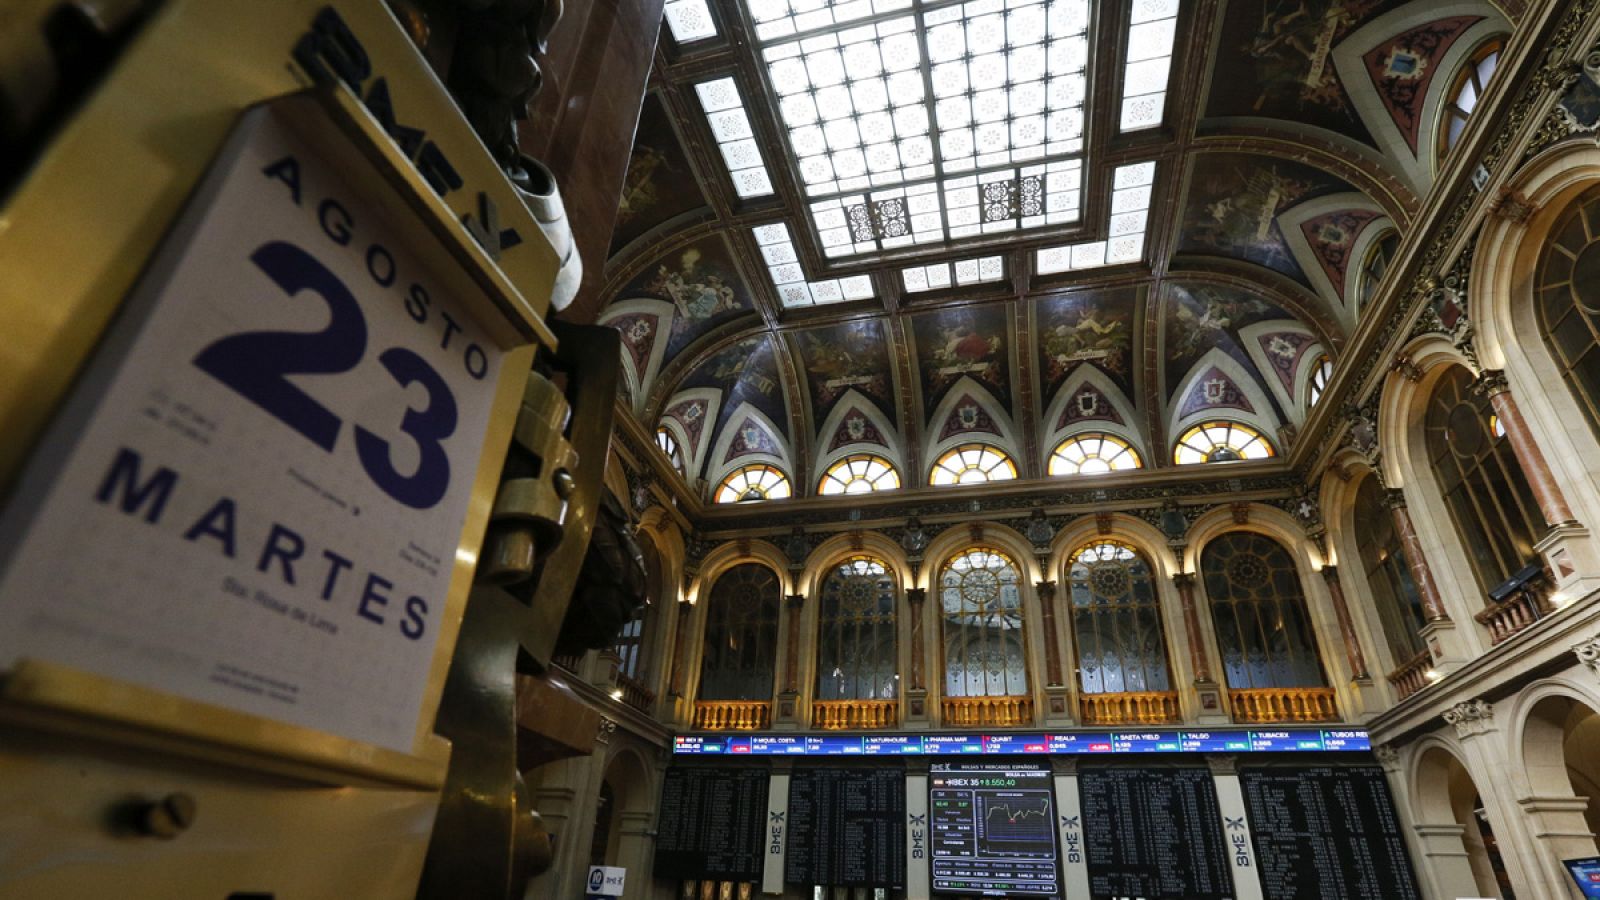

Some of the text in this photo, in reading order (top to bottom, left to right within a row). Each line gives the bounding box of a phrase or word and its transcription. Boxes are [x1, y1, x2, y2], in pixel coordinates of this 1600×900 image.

[263, 154, 489, 381] AGOSTO
[191, 240, 458, 510] 23
[94, 447, 429, 641] MARTES
[770, 825, 782, 854] BME
[912, 829, 924, 859] BME
[1066, 831, 1080, 864] BME
[1231, 833, 1249, 867] BME
